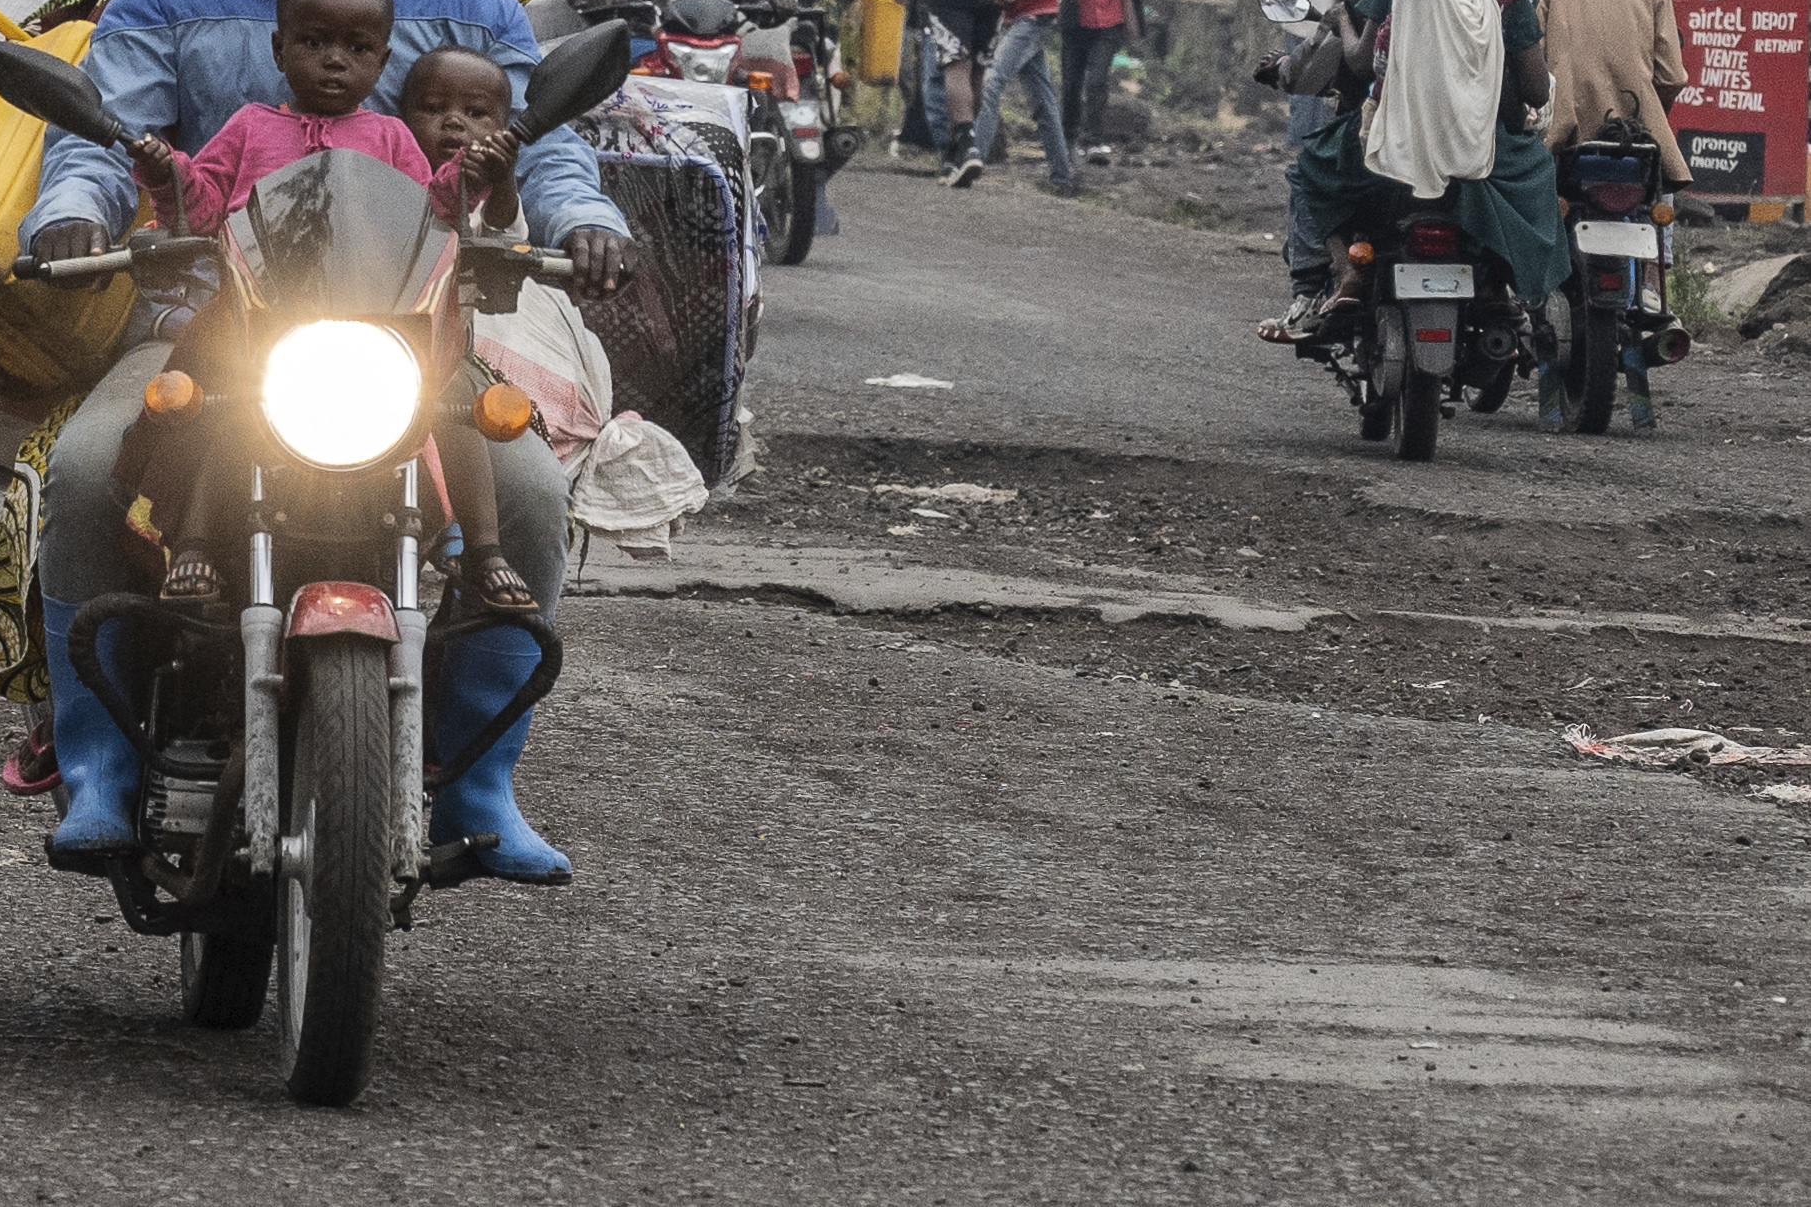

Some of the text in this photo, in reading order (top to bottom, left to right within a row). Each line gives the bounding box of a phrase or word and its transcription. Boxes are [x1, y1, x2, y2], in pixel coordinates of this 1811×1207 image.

[1689, 6, 1746, 32] airtel
[1752, 10, 1798, 31] DEPOT
[1692, 31, 1742, 48] money
[1754, 39, 1804, 53] RETRAIT
[1705, 48, 1749, 70] VENTE
[1701, 67, 1752, 90] UNITES
[1718, 89, 1765, 112] DETAIL
[1690, 155, 1739, 173] money
